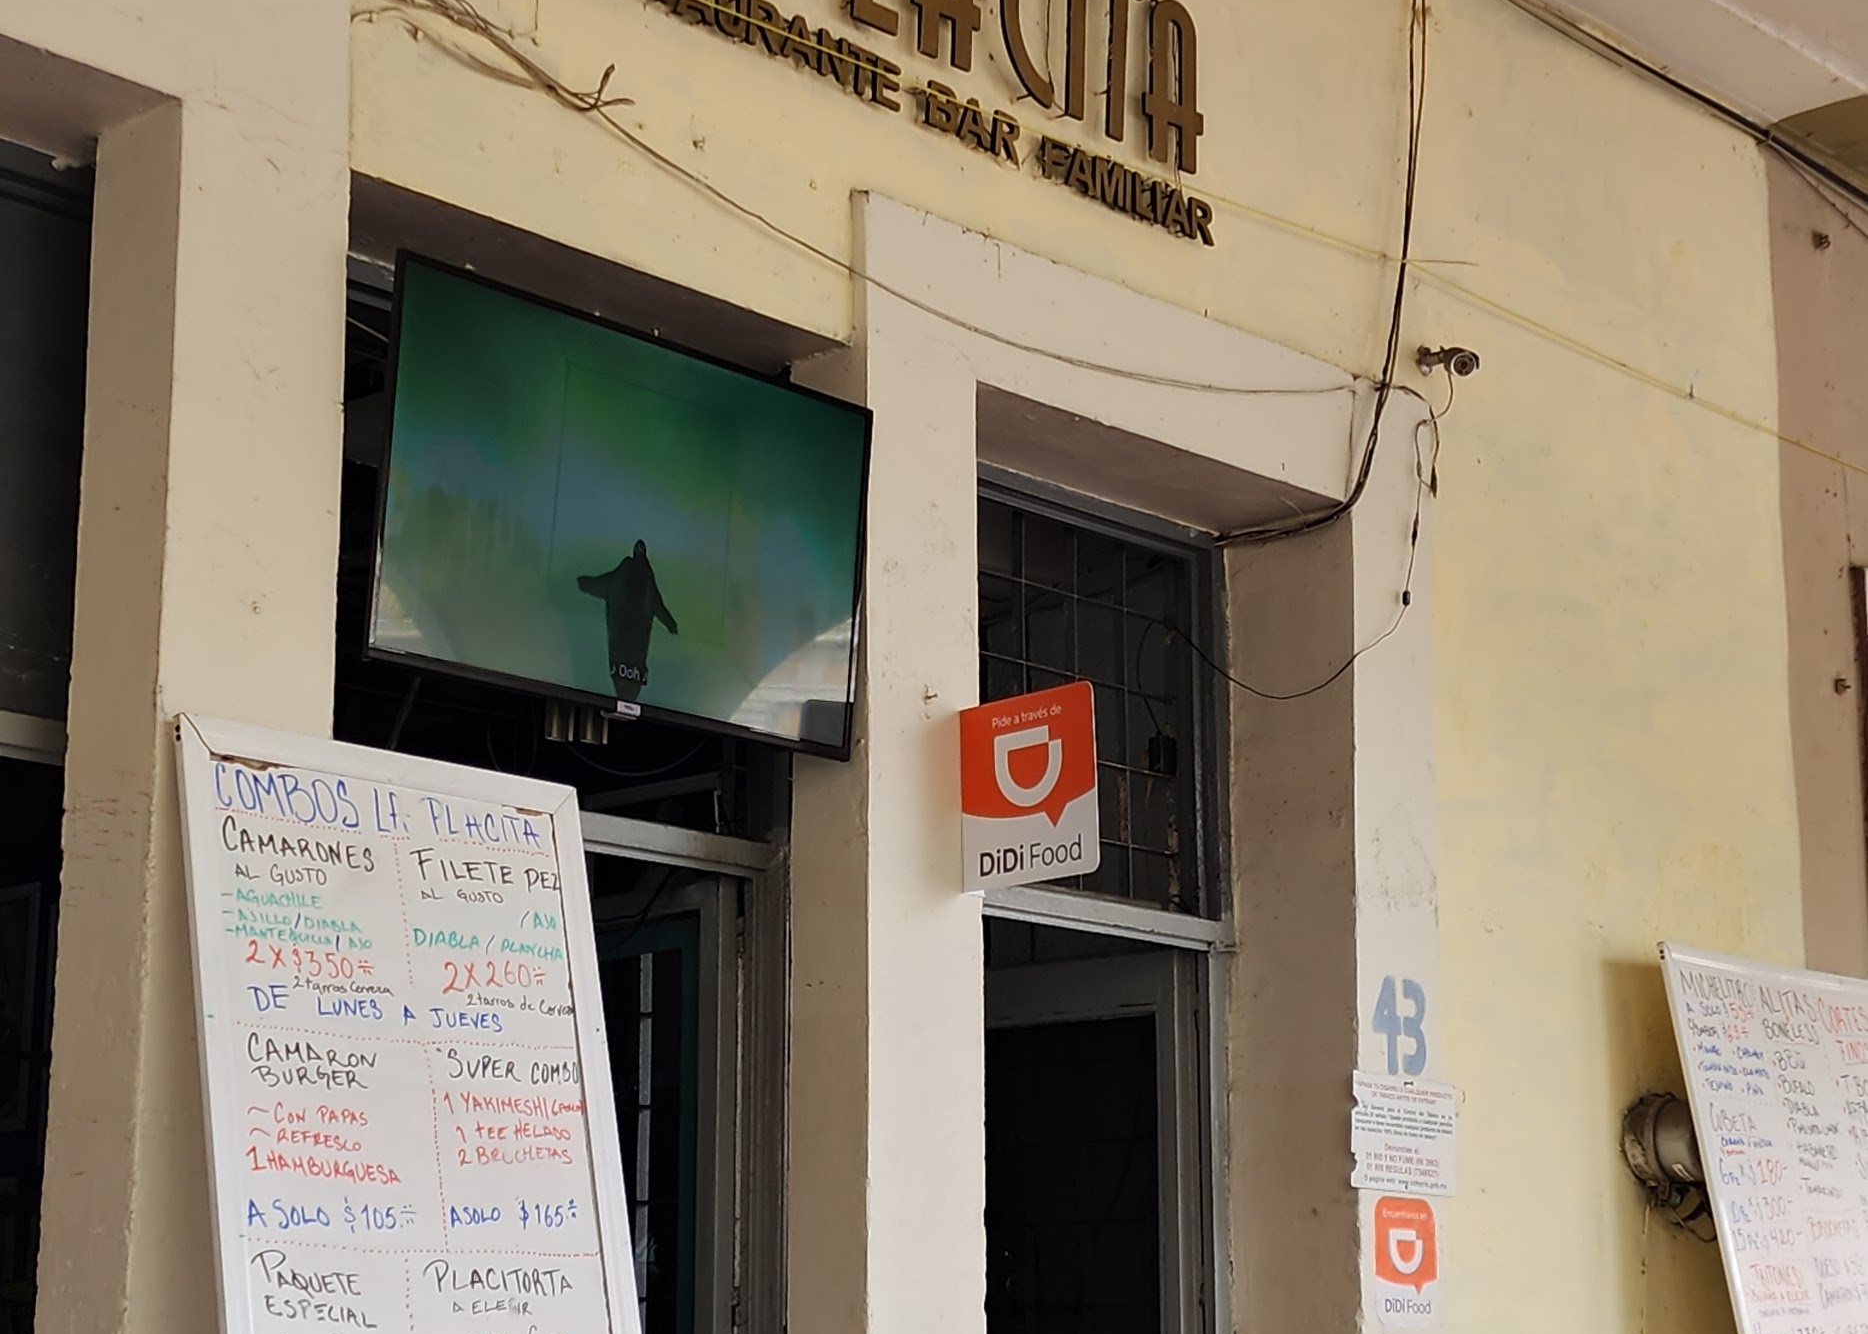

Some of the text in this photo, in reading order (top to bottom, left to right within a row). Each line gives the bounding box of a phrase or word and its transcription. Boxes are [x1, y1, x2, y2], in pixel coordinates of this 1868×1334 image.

[921, 78, 1022, 168] BAR
[1038, 135, 1216, 247] FAMILIAR
[991, 704, 1063, 729] Pide a través de
[215, 761, 360, 828] COMBOS
[419, 796, 541, 850] PLACITA
[221, 814, 375, 873] CAMARONES
[979, 833, 1083, 878] DiDi Food
[234, 862, 328, 887] AL GUSTO
[409, 847, 515, 885] FILETE
[420, 887, 505, 904] AL GUSTO
[413, 927, 481, 948] DIABLA
[247, 984, 504, 1034] DE LUNES A JUEVES
[1371, 975, 1428, 1077] 43
[247, 1031, 377, 1068] CAMARON
[447, 1048, 522, 1083] SUPER
[250, 1064, 369, 1091] BURGER
[316, 1104, 369, 1127] PAPAS
[459, 1090, 550, 1121] YAKIMESHI
[276, 1128, 362, 1152] REFRESCO
[266, 1149, 402, 1185] HAMBURGUESA
[458, 1148, 472, 1167] 2
[247, 1198, 267, 1228] A
[272, 1198, 330, 1230] SOLO
[250, 1248, 362, 1299] PAQUETE
[423, 1258, 573, 1297] PLACITORTA
[264, 1295, 378, 1329] ESPECIAL
[452, 1300, 465, 1314] A
[1384, 1298, 1432, 1315] DiDi Food
